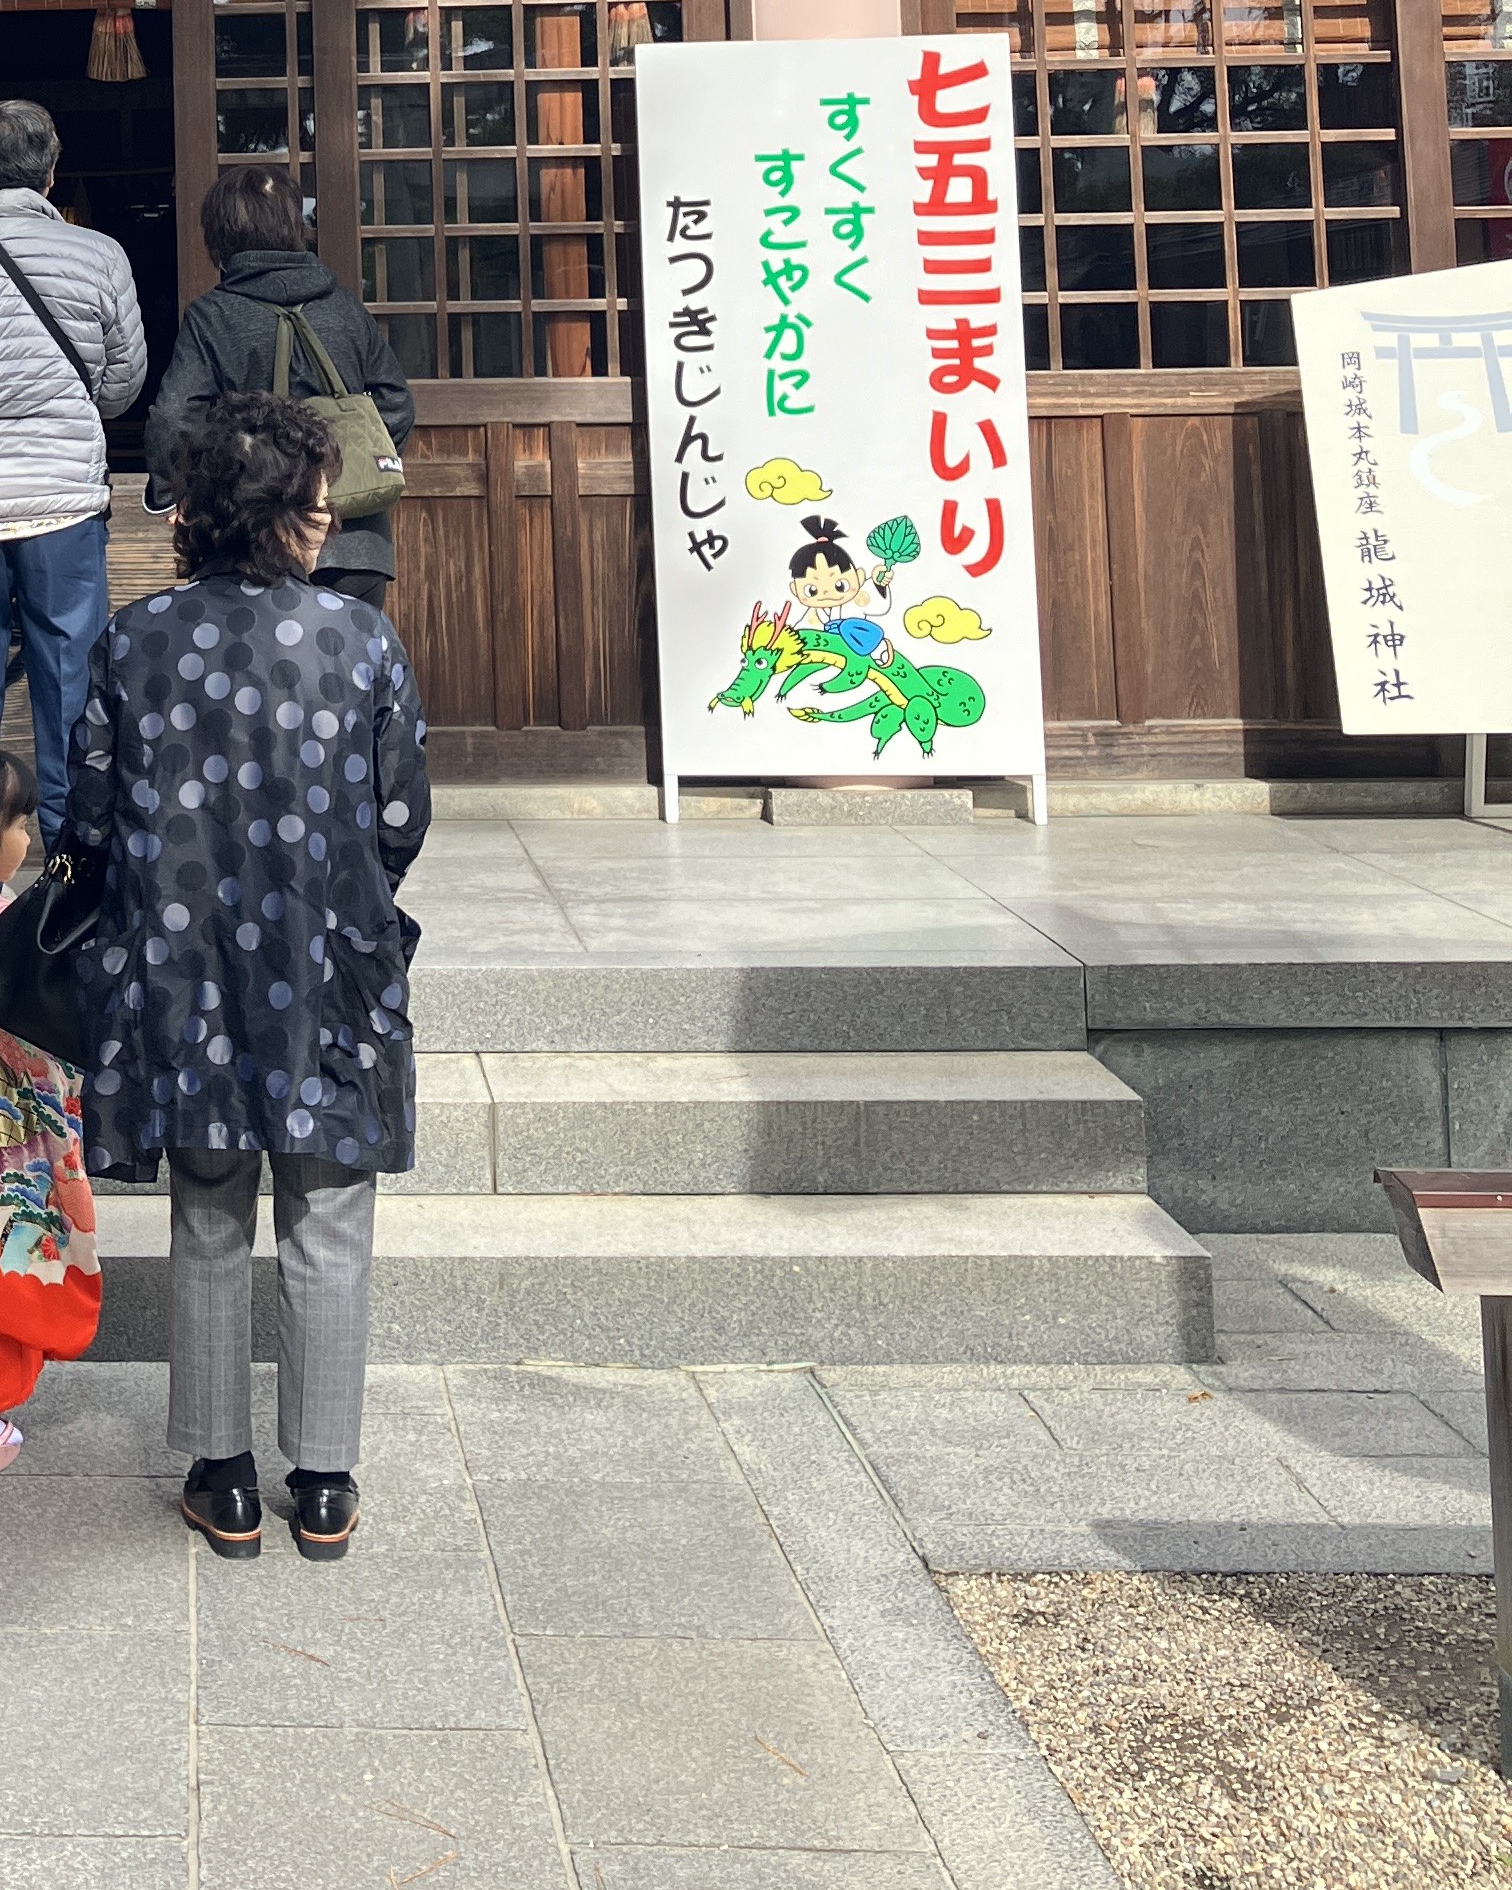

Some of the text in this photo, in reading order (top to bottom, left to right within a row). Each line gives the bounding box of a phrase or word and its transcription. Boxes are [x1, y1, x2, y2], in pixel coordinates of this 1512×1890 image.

[754, 148, 815, 418] すこやかに
[819, 91, 876, 303] すくすく
[907, 50, 1008, 578] 七五三まいり
[665, 195, 729, 571] たつきじんじゃ
[1341, 351, 1414, 706] 岡崎城本丸鎮座 龍城神社
